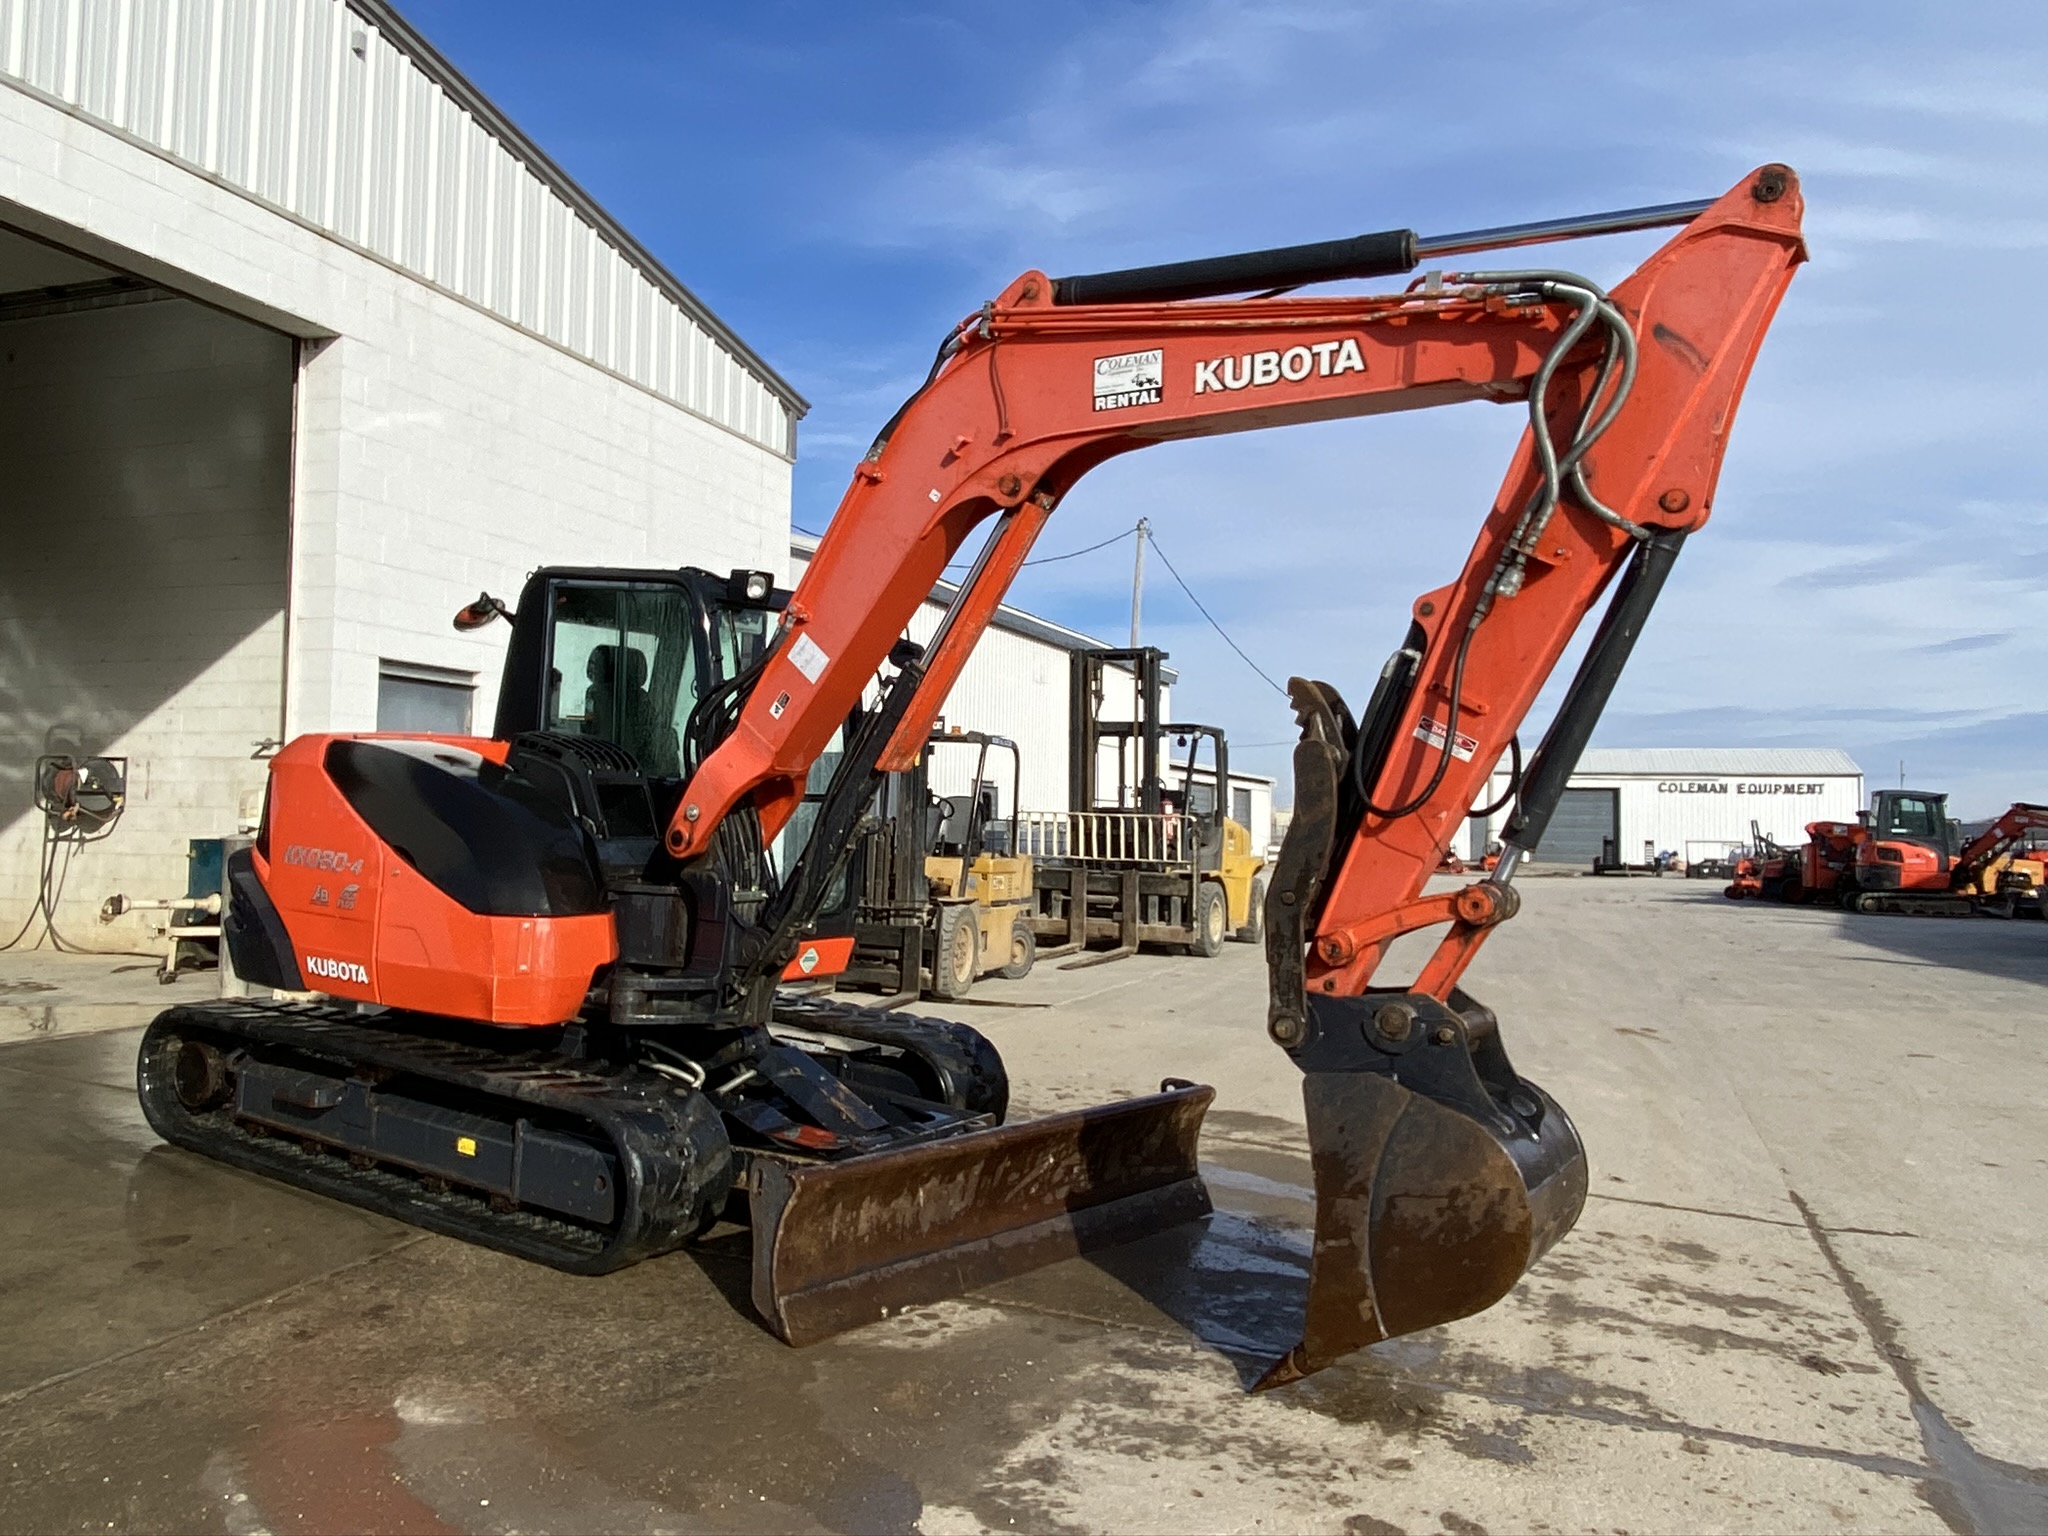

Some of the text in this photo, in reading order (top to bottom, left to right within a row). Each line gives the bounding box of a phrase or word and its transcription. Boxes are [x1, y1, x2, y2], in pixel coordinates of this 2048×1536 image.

[1097, 352, 1161, 376] COLEMAN
[1194, 338, 1366, 394] KUBOTA
[1094, 389, 1161, 411] RENTAL
[1657, 781, 1825, 795] COLEMAN EQUIPMENT
[306, 955, 369, 984] KUBOTA
